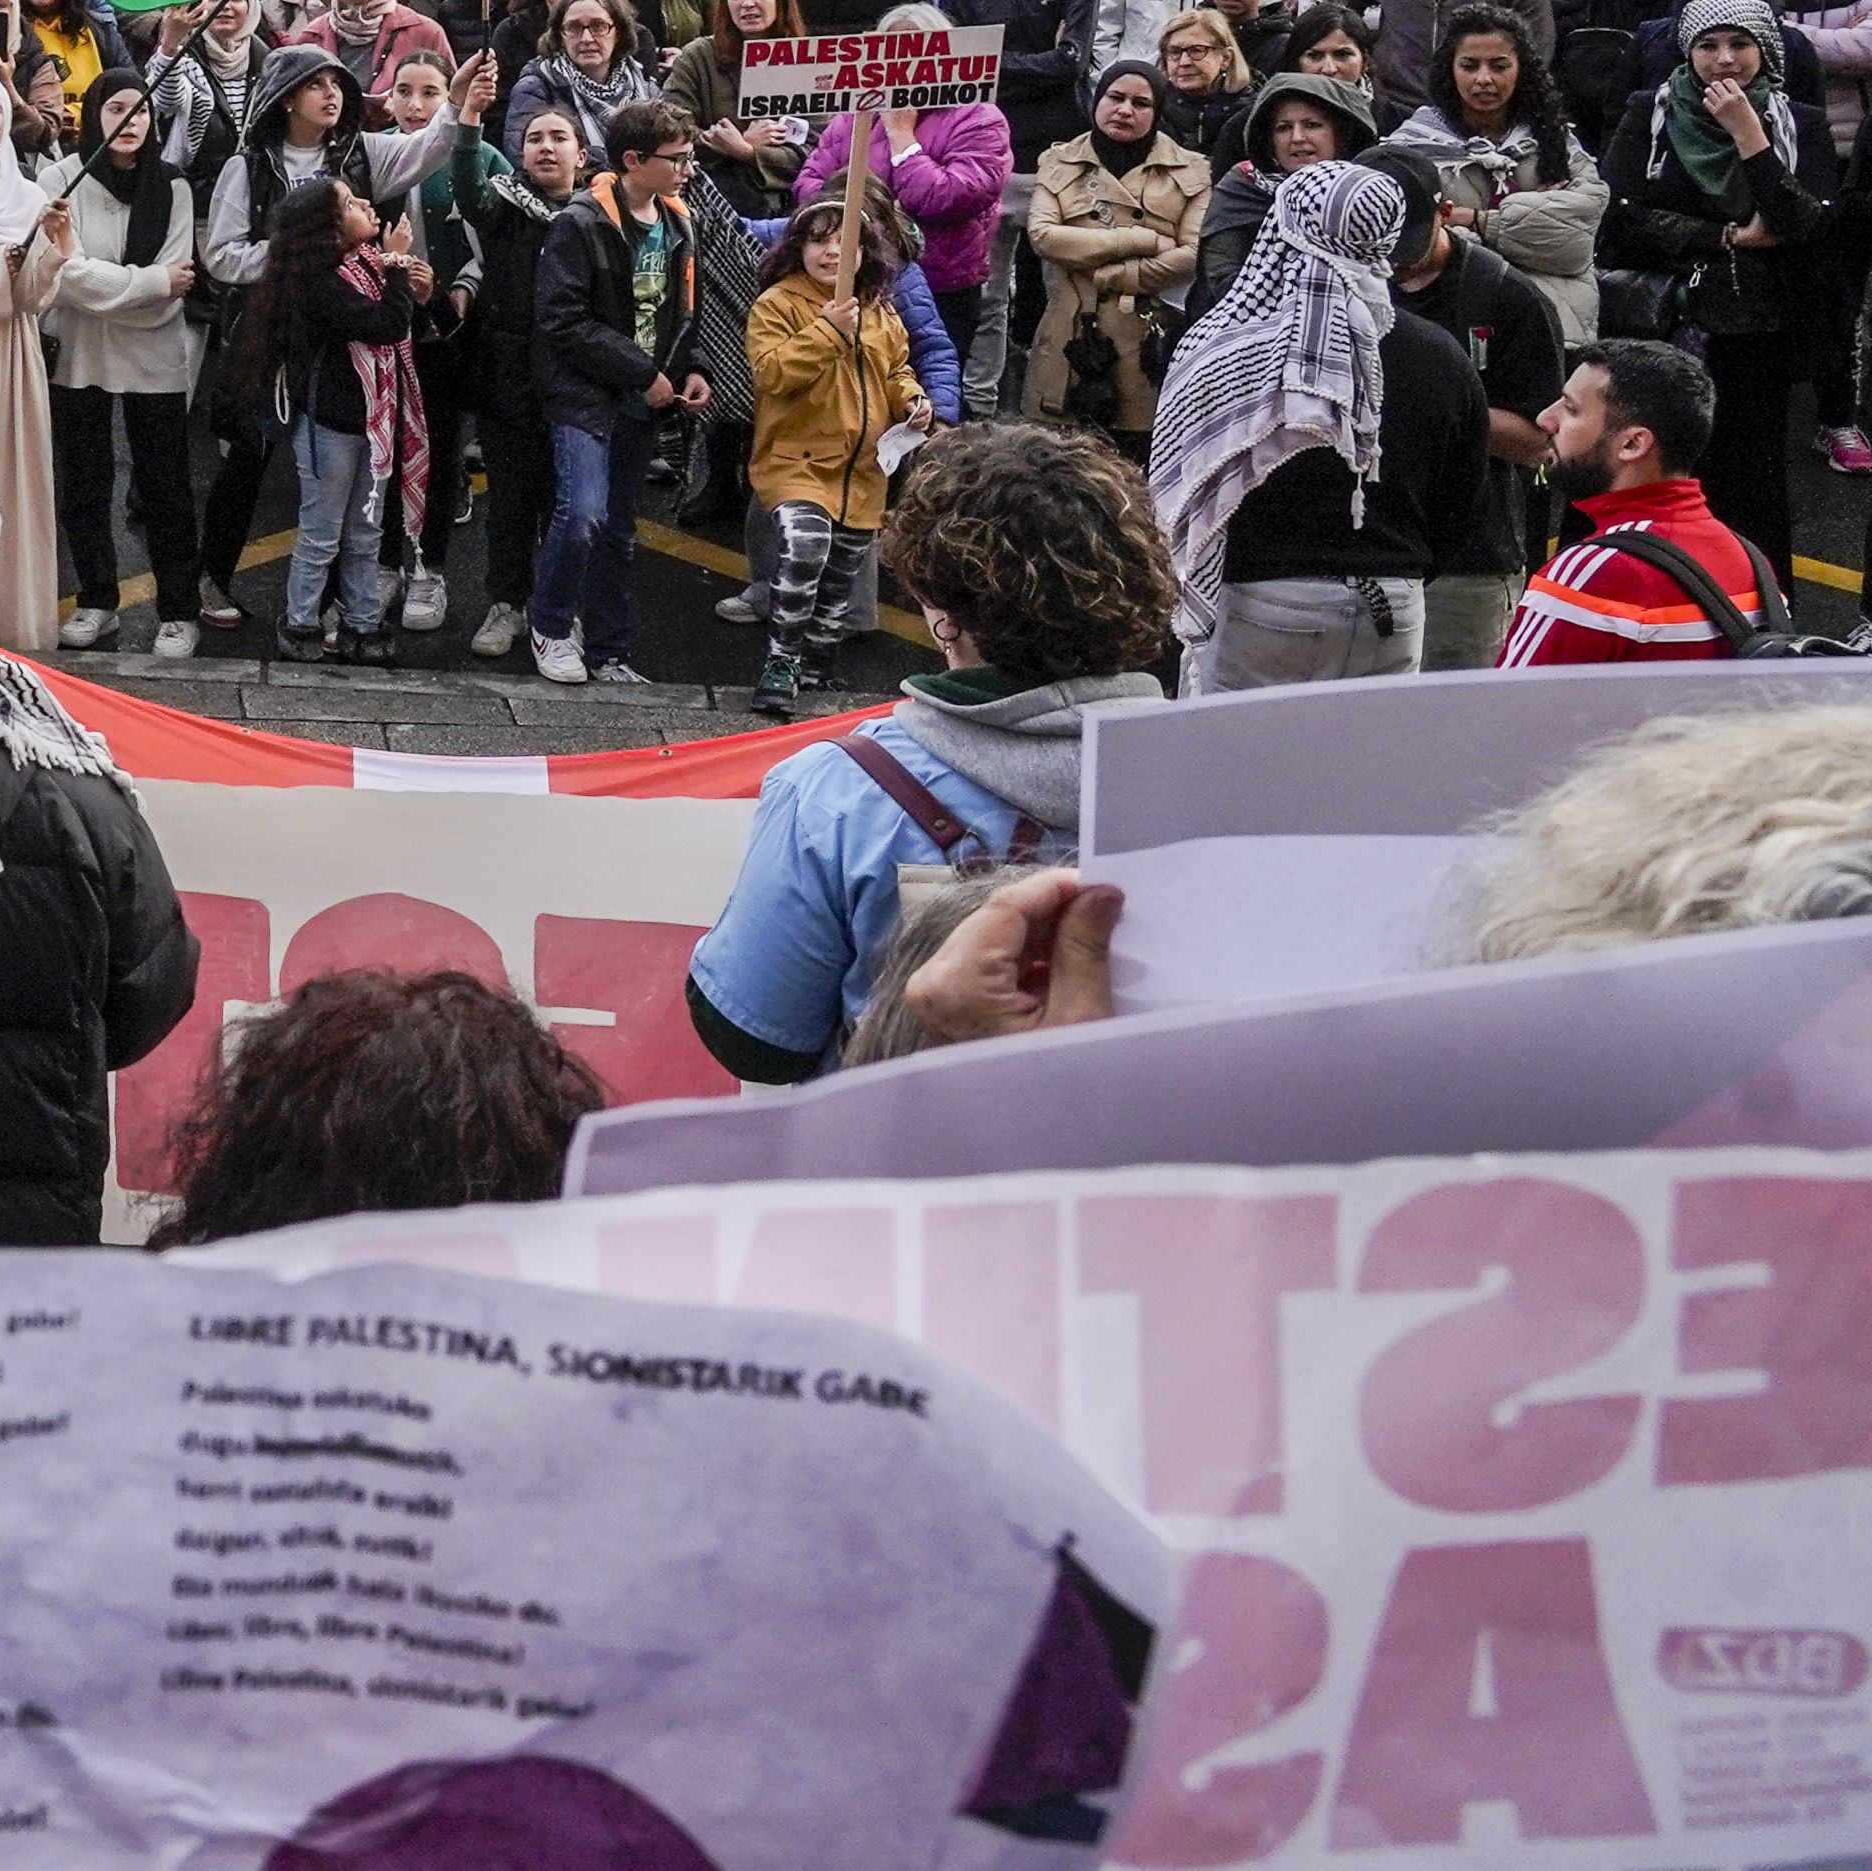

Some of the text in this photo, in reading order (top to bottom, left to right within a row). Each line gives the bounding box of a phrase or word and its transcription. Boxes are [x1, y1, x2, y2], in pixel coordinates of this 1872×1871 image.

[745, 31, 951, 67] PALESTINA
[833, 54, 998, 90] ASKATU!
[740, 82, 996, 117] ISRAELI BOIKOT
[307, 1316, 533, 1377] PALESTINA,
